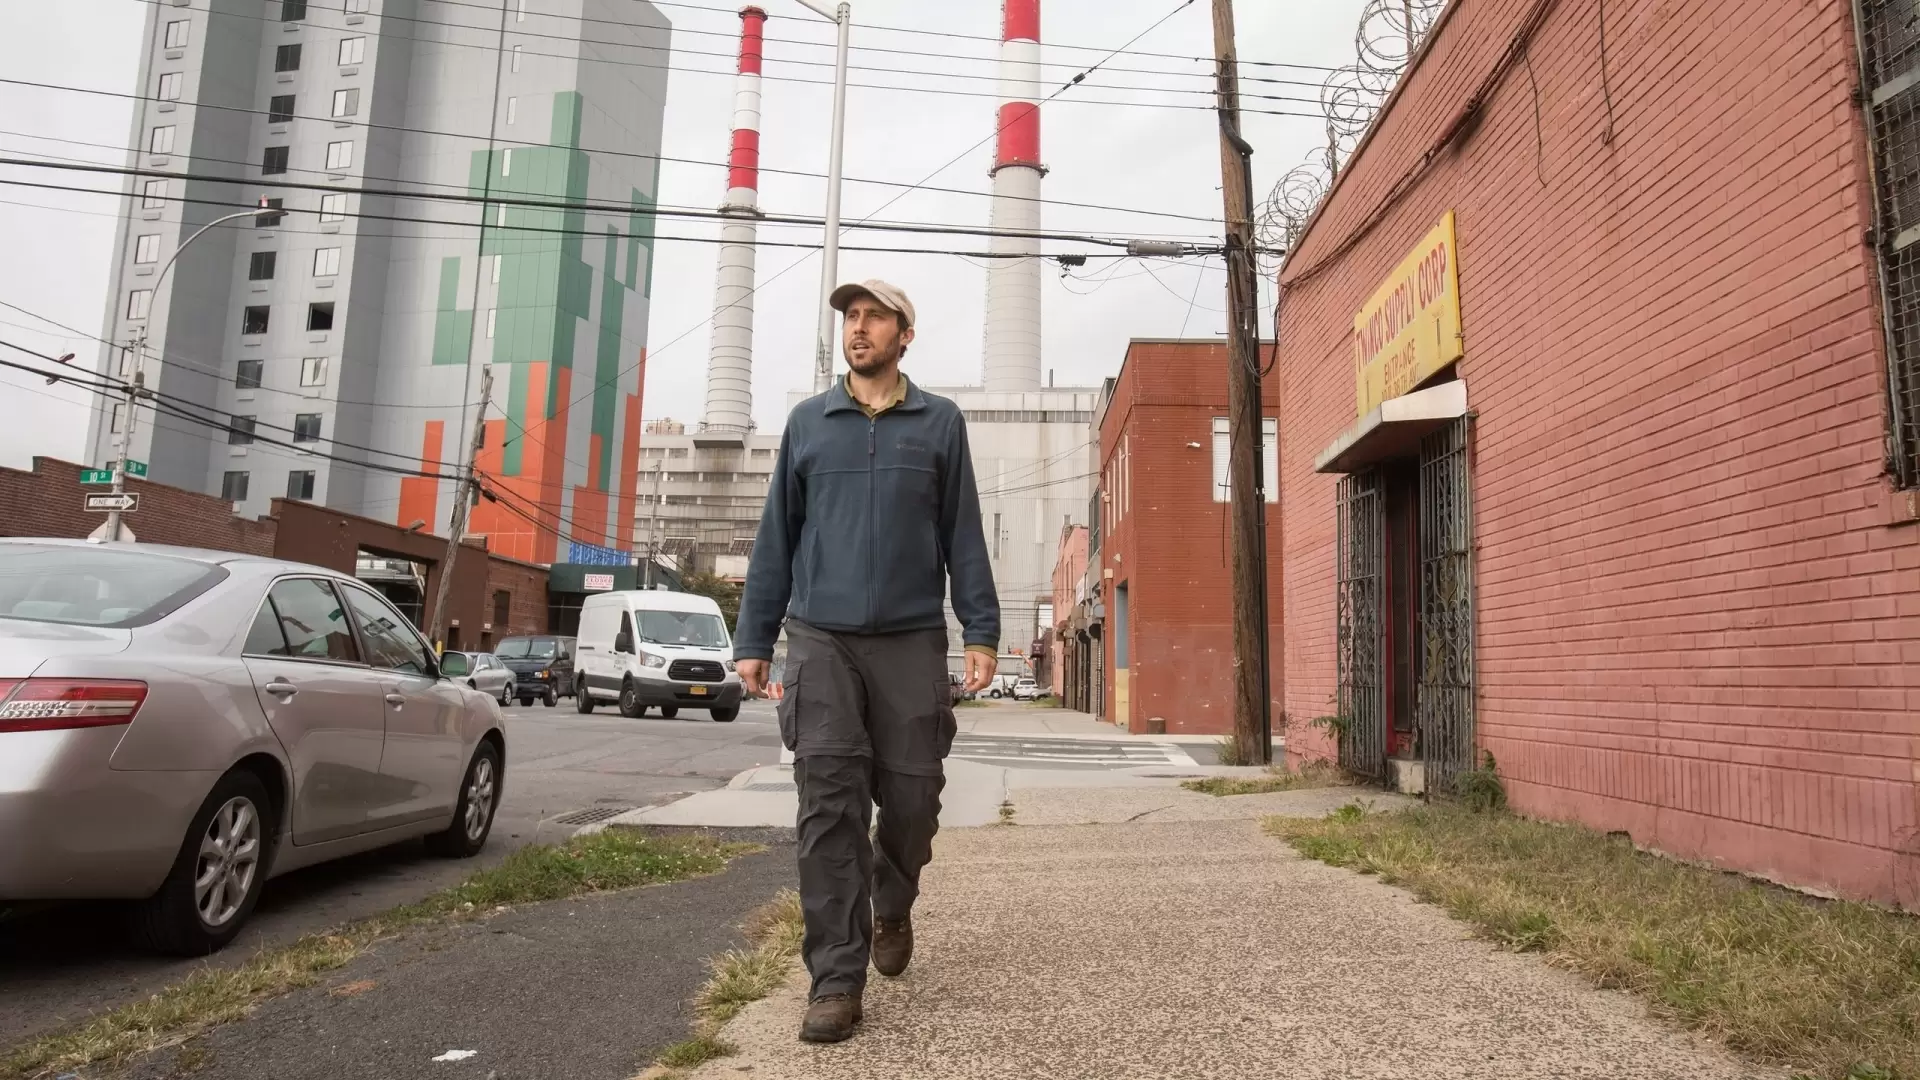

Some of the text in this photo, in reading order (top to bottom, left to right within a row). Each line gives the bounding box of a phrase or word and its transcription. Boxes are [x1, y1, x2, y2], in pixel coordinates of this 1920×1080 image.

[1385, 269, 1415, 344] SUPPLY
[1418, 242, 1446, 310] CORP
[1384, 338, 1416, 385] ENTRANCE
[89, 472, 98, 483] 10
